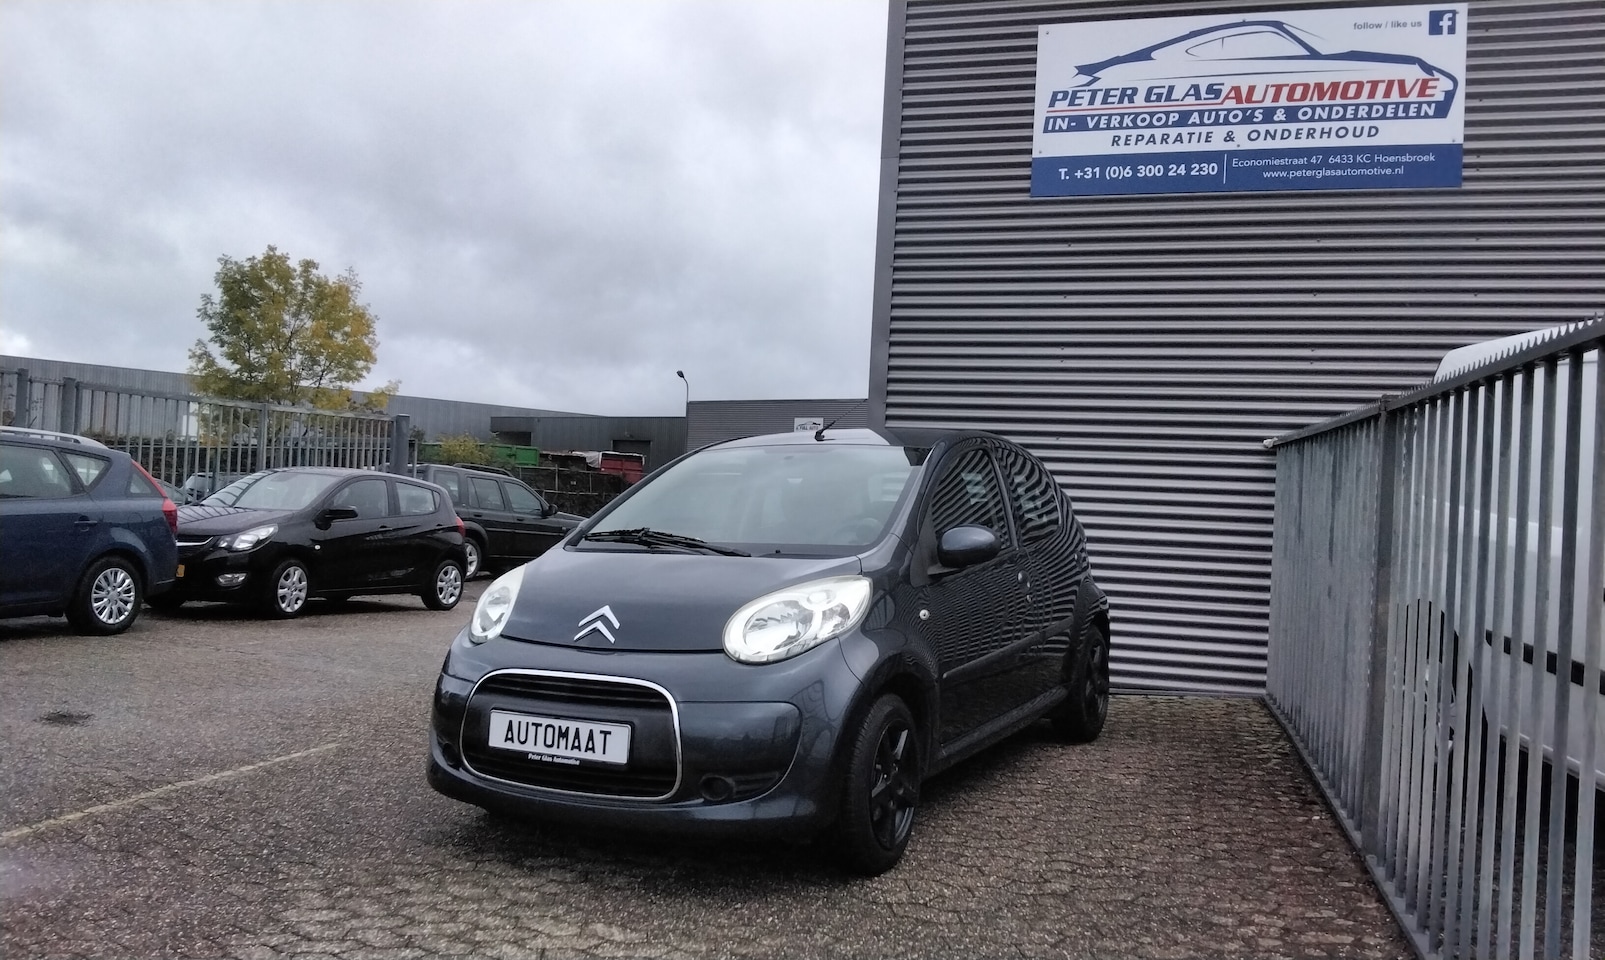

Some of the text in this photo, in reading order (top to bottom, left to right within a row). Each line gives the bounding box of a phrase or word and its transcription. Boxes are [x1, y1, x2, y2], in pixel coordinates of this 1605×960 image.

[1353, 21, 1382, 30] follow
[1391, 20, 1407, 28] like
[1410, 20, 1422, 28] us
[1048, 87, 1138, 108] PETER
[1047, 103, 1436, 130] IN- VERKOOP AUTO'S & ONDERDELEN
[1111, 125, 1380, 147] REPARATIE & ONDERHOUD
[1232, 152, 1436, 167] Economiestraat 47 6433 KC Hoensbroek
[1058, 163, 1218, 180] T. +31 (0)6 300 24 230
[1263, 166, 1404, 178] www.peterglasautomotive.nl
[504, 719, 611, 755] AUTOMAAT
